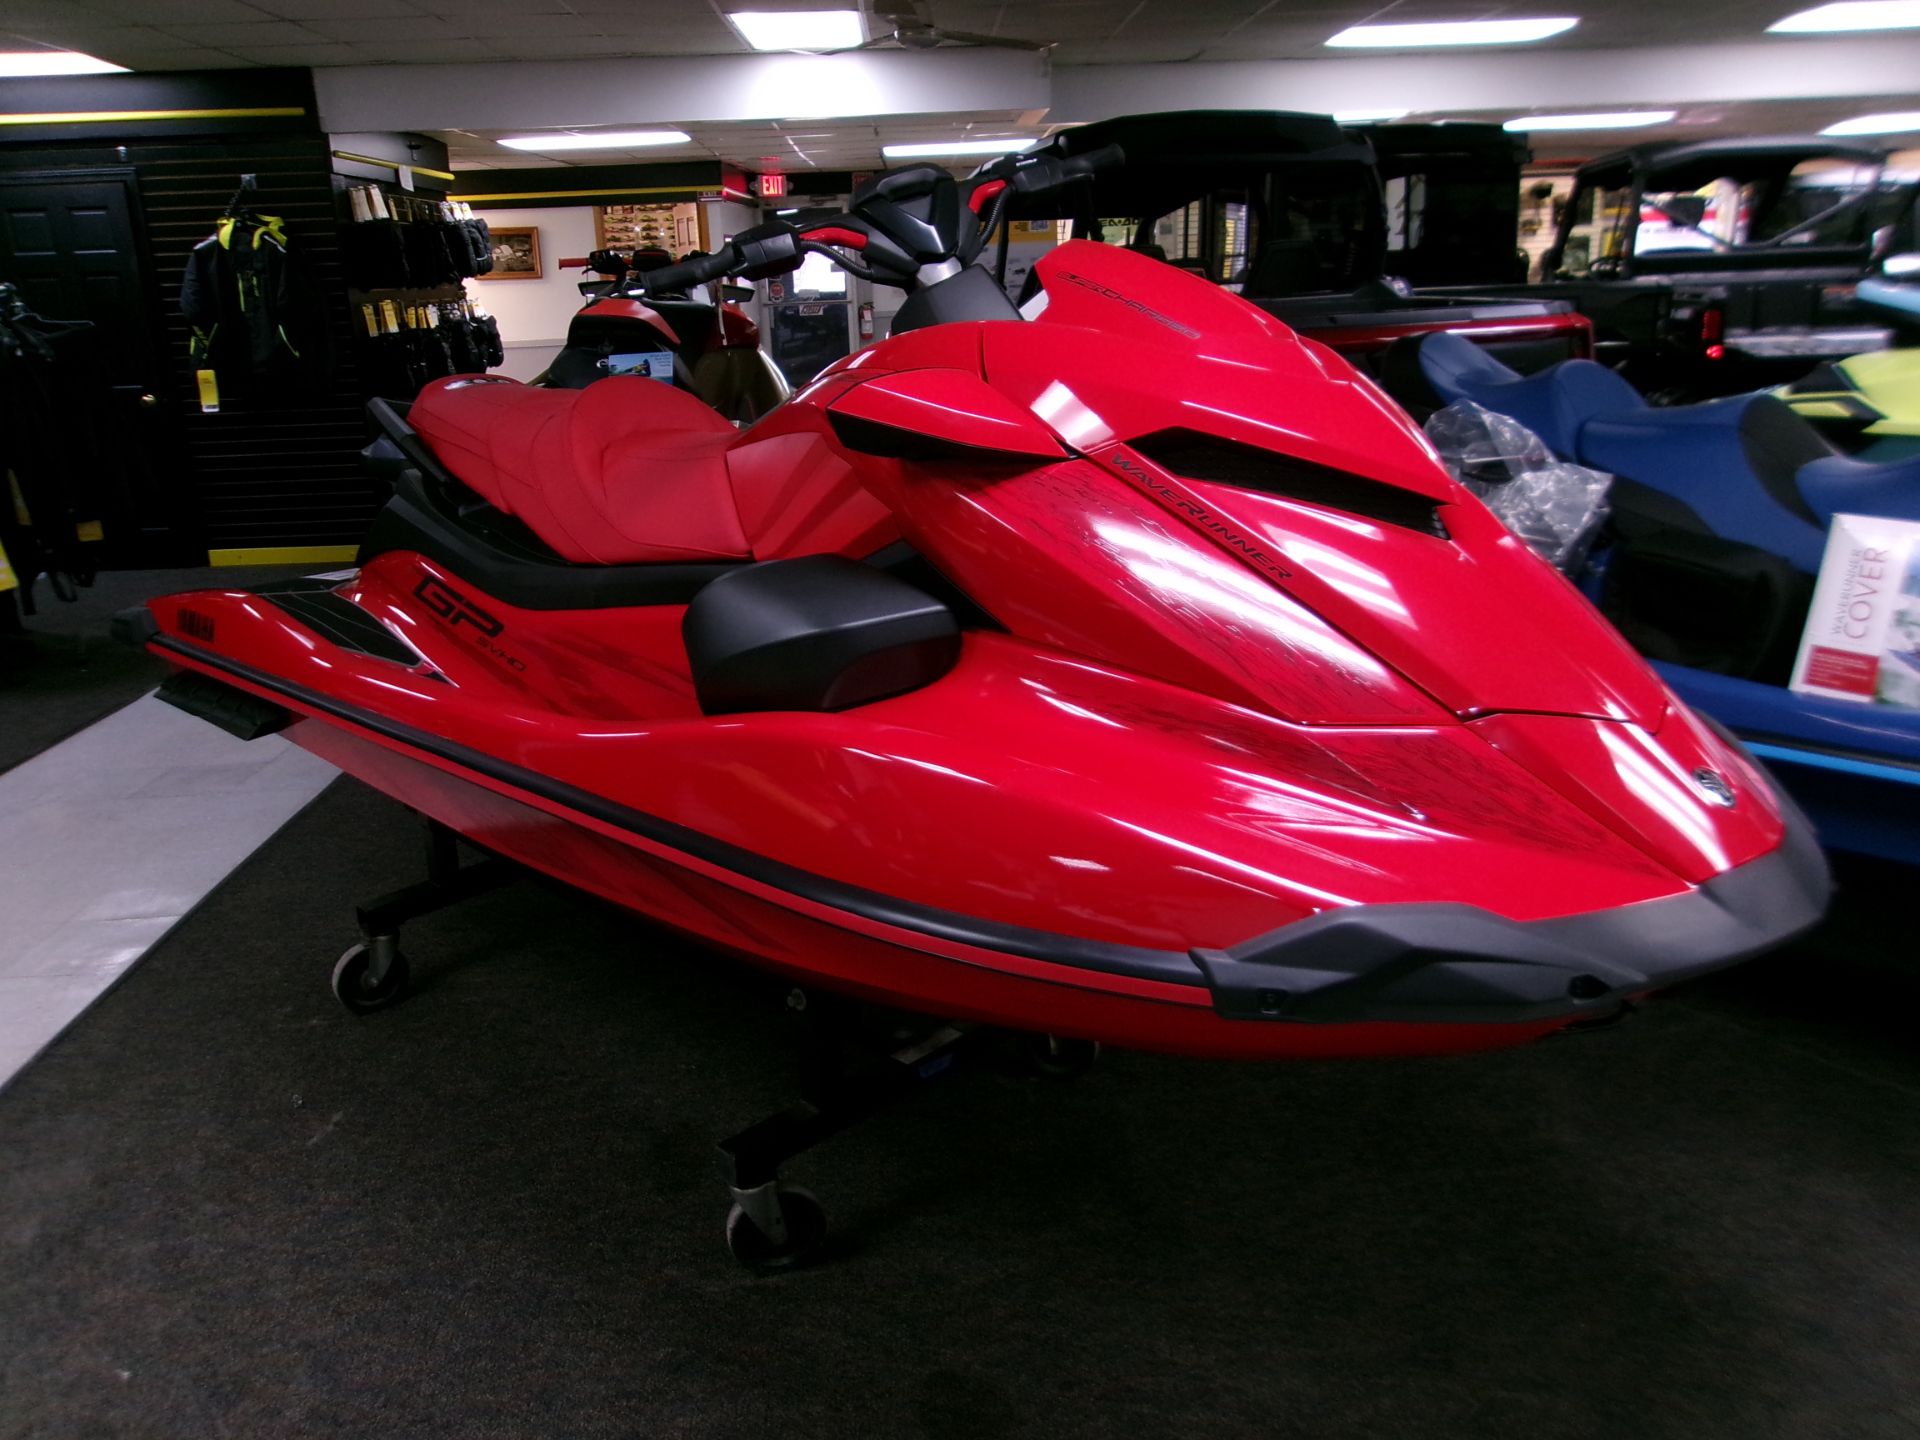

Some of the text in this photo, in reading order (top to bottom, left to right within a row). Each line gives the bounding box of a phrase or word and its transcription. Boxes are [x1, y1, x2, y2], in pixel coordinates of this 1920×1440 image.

[762, 176, 783, 195] EXIT
[1111, 453, 1293, 580] WAVERUNNER
[413, 576, 505, 638] GP
[1843, 547, 1888, 640] COVER
